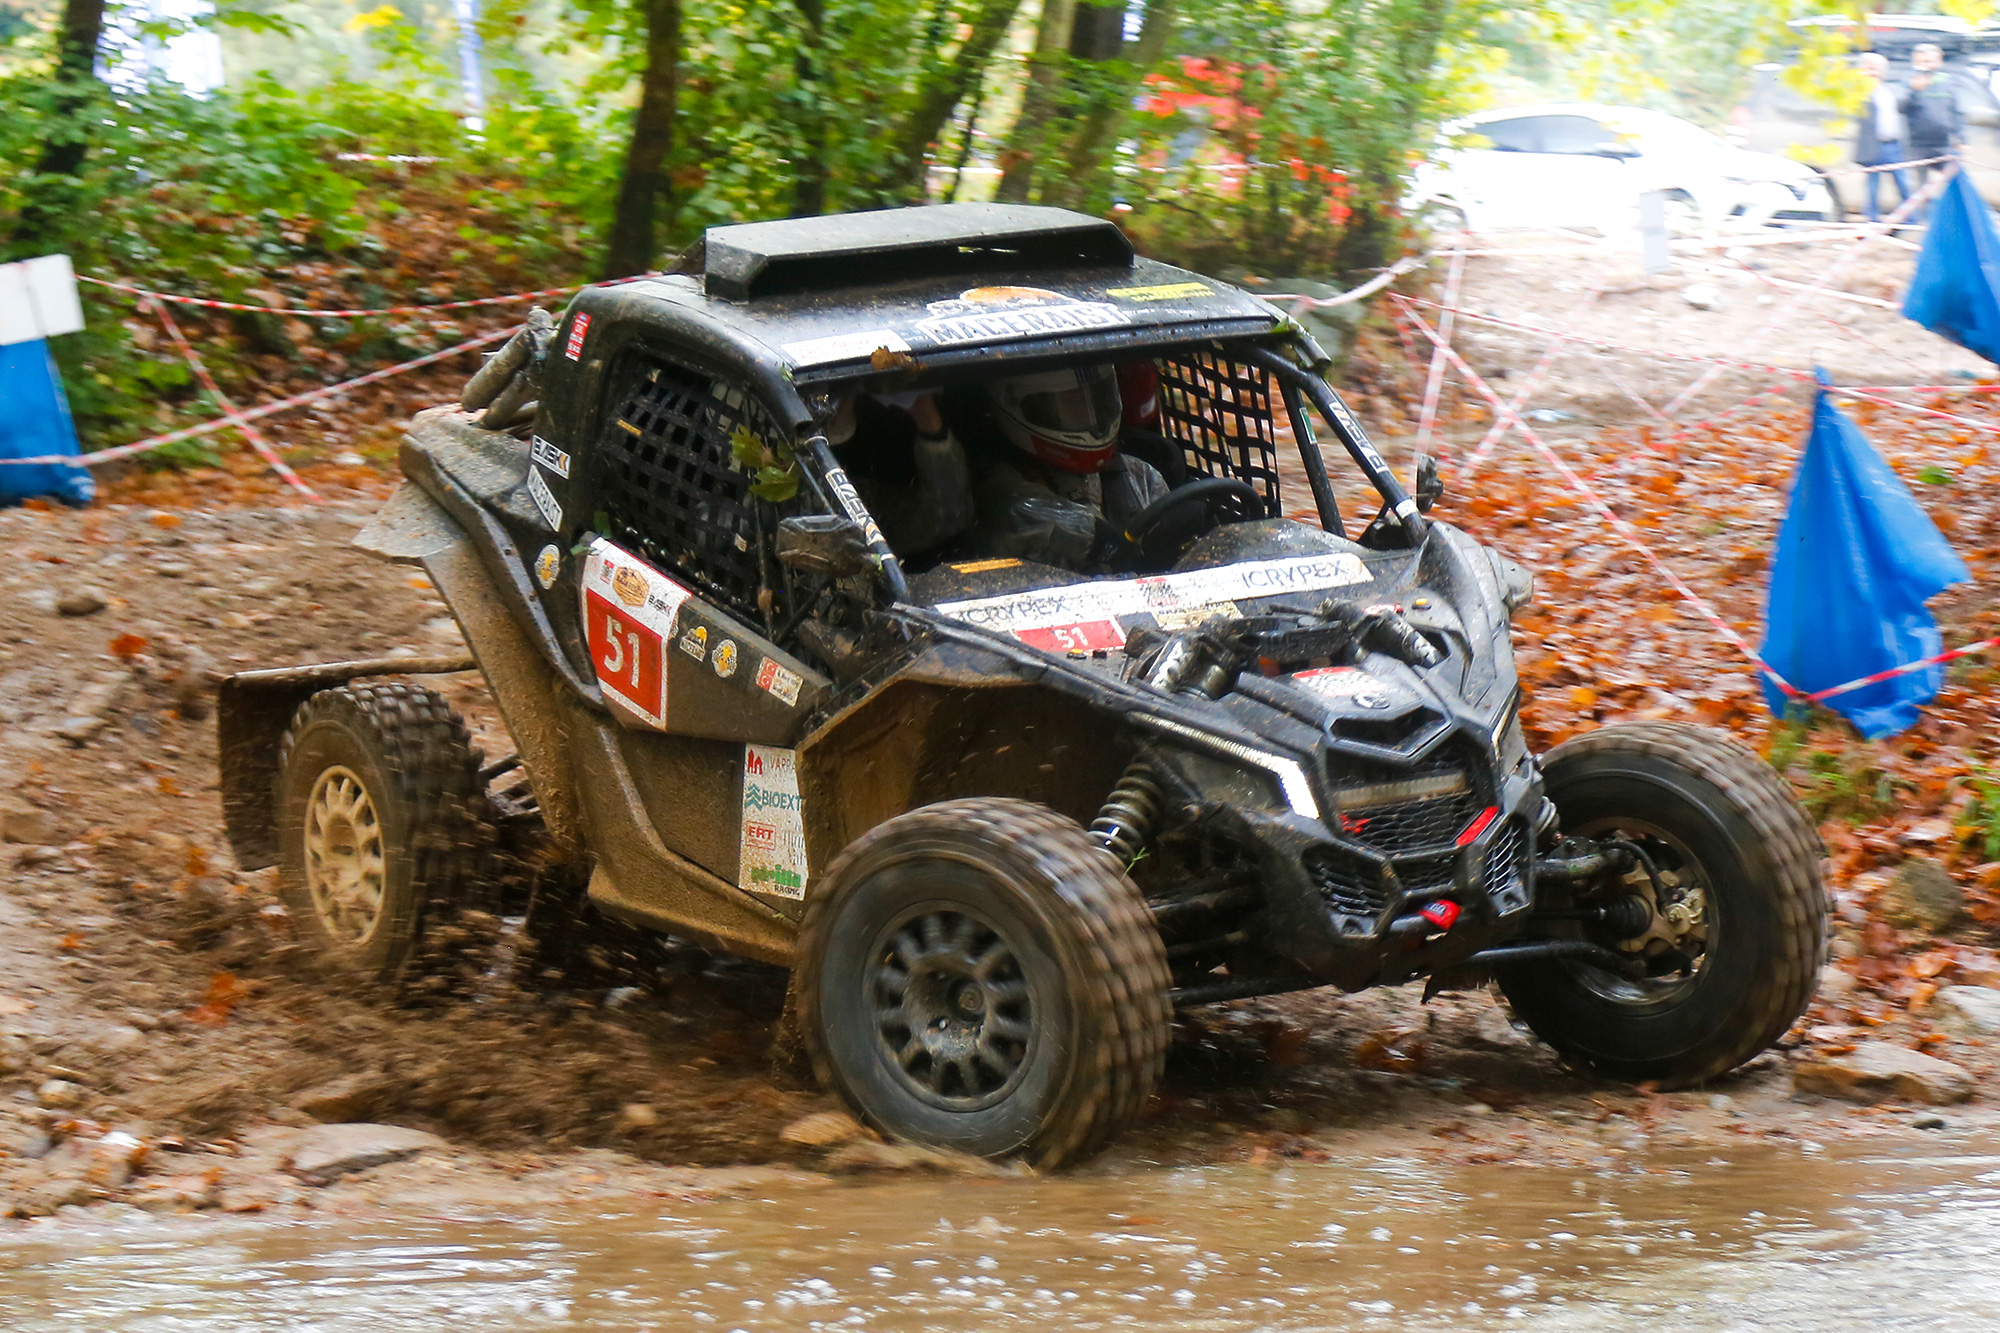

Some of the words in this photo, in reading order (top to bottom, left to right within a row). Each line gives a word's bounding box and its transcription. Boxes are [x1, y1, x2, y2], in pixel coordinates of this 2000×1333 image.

[1242, 559, 1347, 588] ICRYPEX
[1054, 626, 1089, 649] 51
[604, 615, 640, 689] 51
[748, 825, 774, 841] ERT
